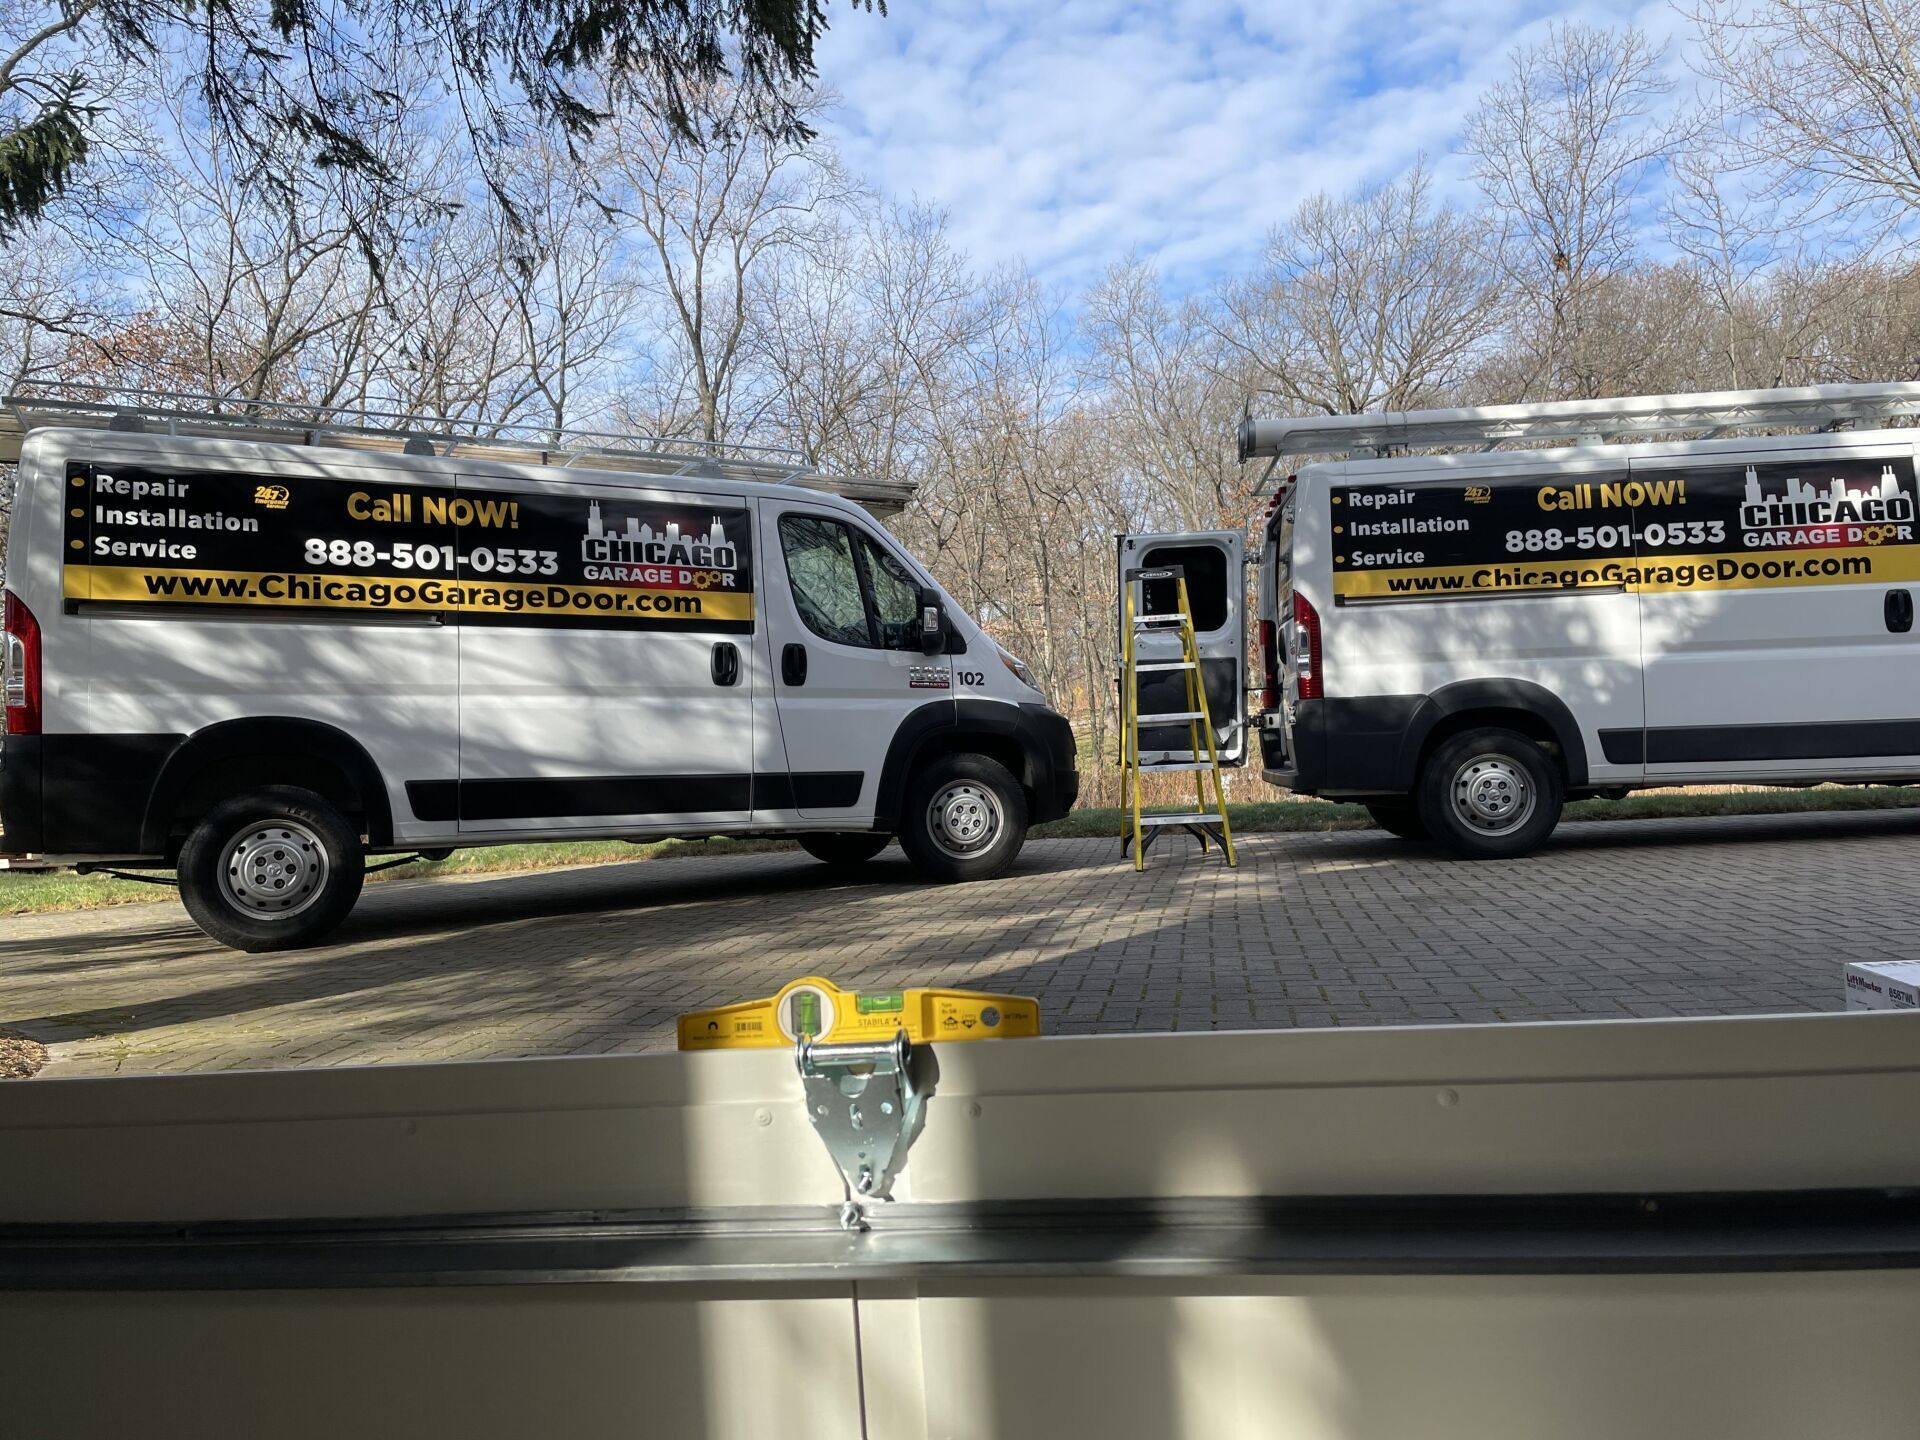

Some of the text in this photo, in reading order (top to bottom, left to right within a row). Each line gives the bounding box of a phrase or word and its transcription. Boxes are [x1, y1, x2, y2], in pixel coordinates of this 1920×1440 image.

[96, 474, 189, 500] Repair
[1349, 489, 1416, 510] Repair
[1537, 479, 1686, 512] Call NOW!
[95, 505, 259, 532] Installation
[347, 492, 519, 530] Call NOW!
[1743, 497, 1912, 527] CHICAGO
[1350, 516, 1470, 537] Installation
[1505, 520, 1726, 553] 888-501-0533
[1743, 529, 1841, 547] GARAGE
[94, 536, 197, 560] Service
[304, 538, 559, 575] 888-501-0533
[583, 538, 736, 569] CHICAGO
[1351, 548, 1425, 567] Service
[583, 565, 673, 584] GARAGE
[1387, 556, 1872, 591] wwwChicagoGarageDoor.com
[143, 574, 703, 613] www.ChicagoGarageDoor.com
[957, 671, 985, 686] 102
[858, 1017, 890, 1026] STABILA
